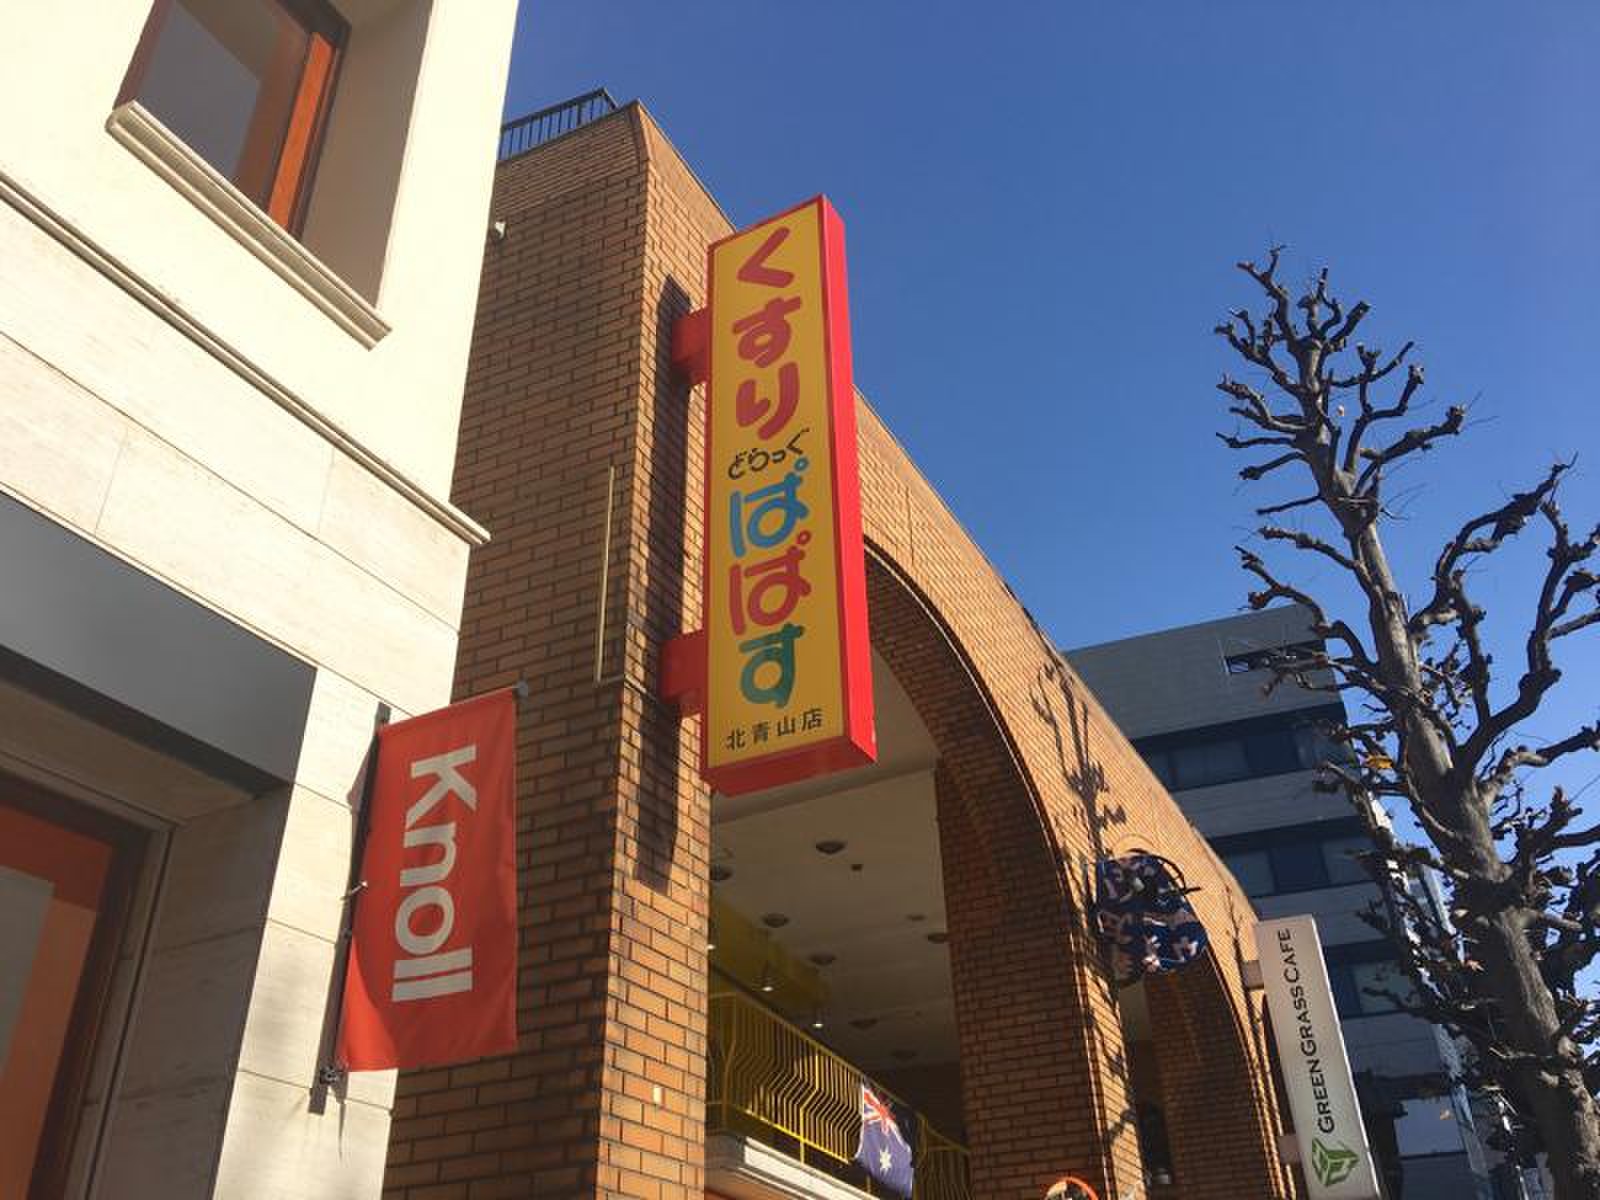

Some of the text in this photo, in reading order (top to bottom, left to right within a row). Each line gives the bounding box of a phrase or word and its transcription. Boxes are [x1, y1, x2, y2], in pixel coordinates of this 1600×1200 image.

[732, 227, 802, 440] くすり
[728, 427, 810, 480] どらっぐ
[729, 457, 812, 708] ぱぱす
[725, 708, 823, 750] 北青山店
[391, 744, 477, 1002] Knoll
